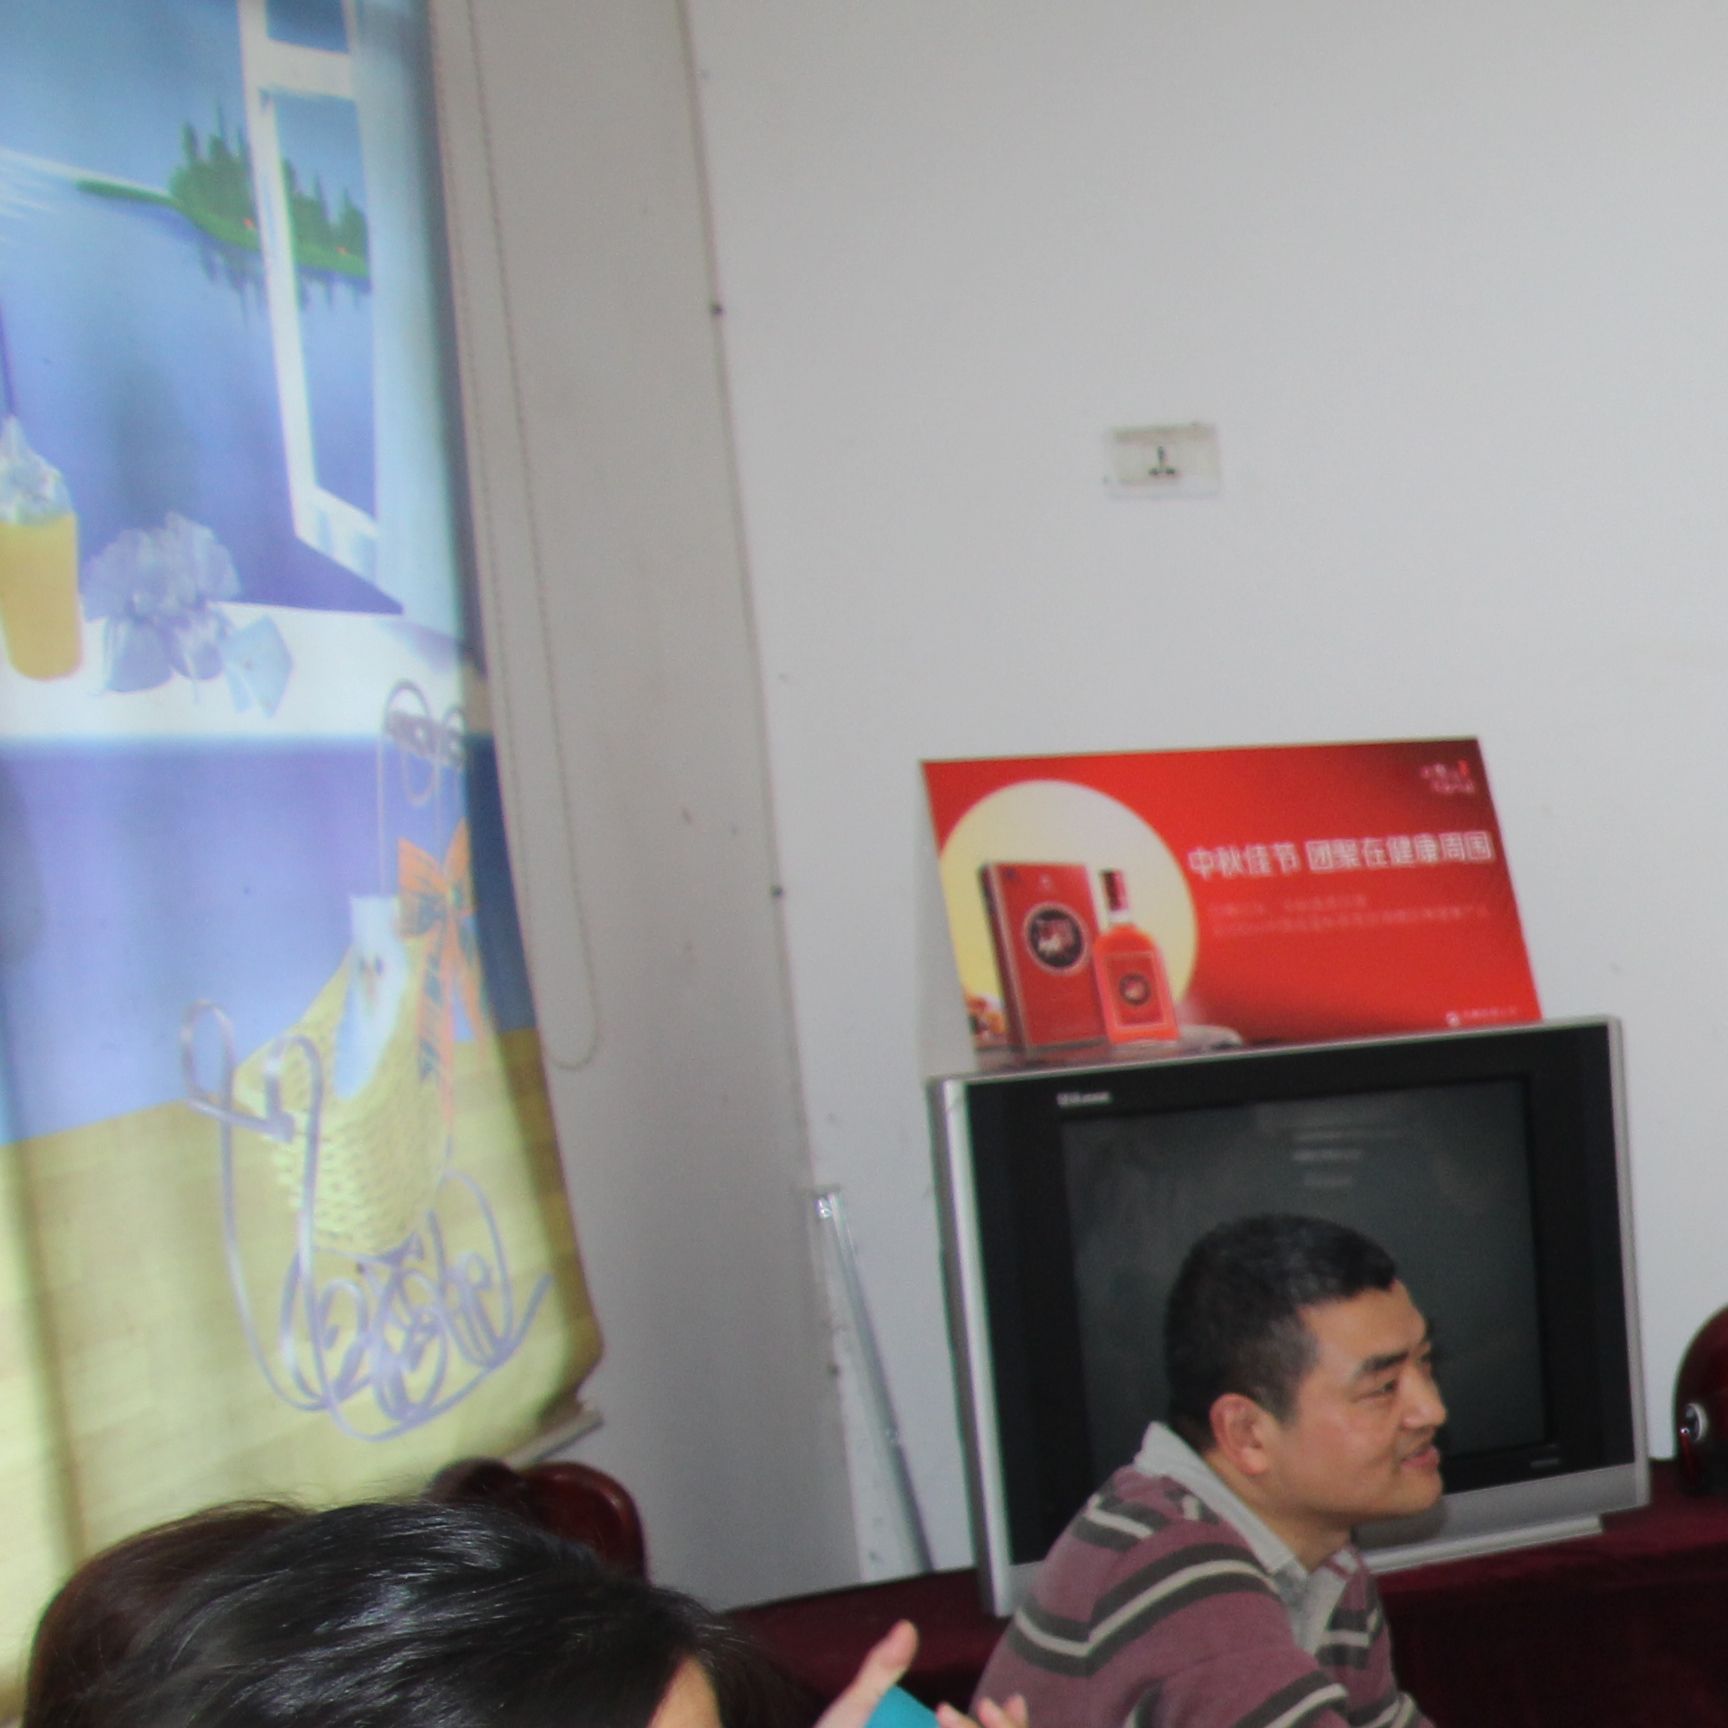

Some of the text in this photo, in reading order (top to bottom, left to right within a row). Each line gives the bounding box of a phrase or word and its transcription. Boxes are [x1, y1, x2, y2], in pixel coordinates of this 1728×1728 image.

[1187, 830, 1495, 880] 中秋佳节 团聚在健康周围
